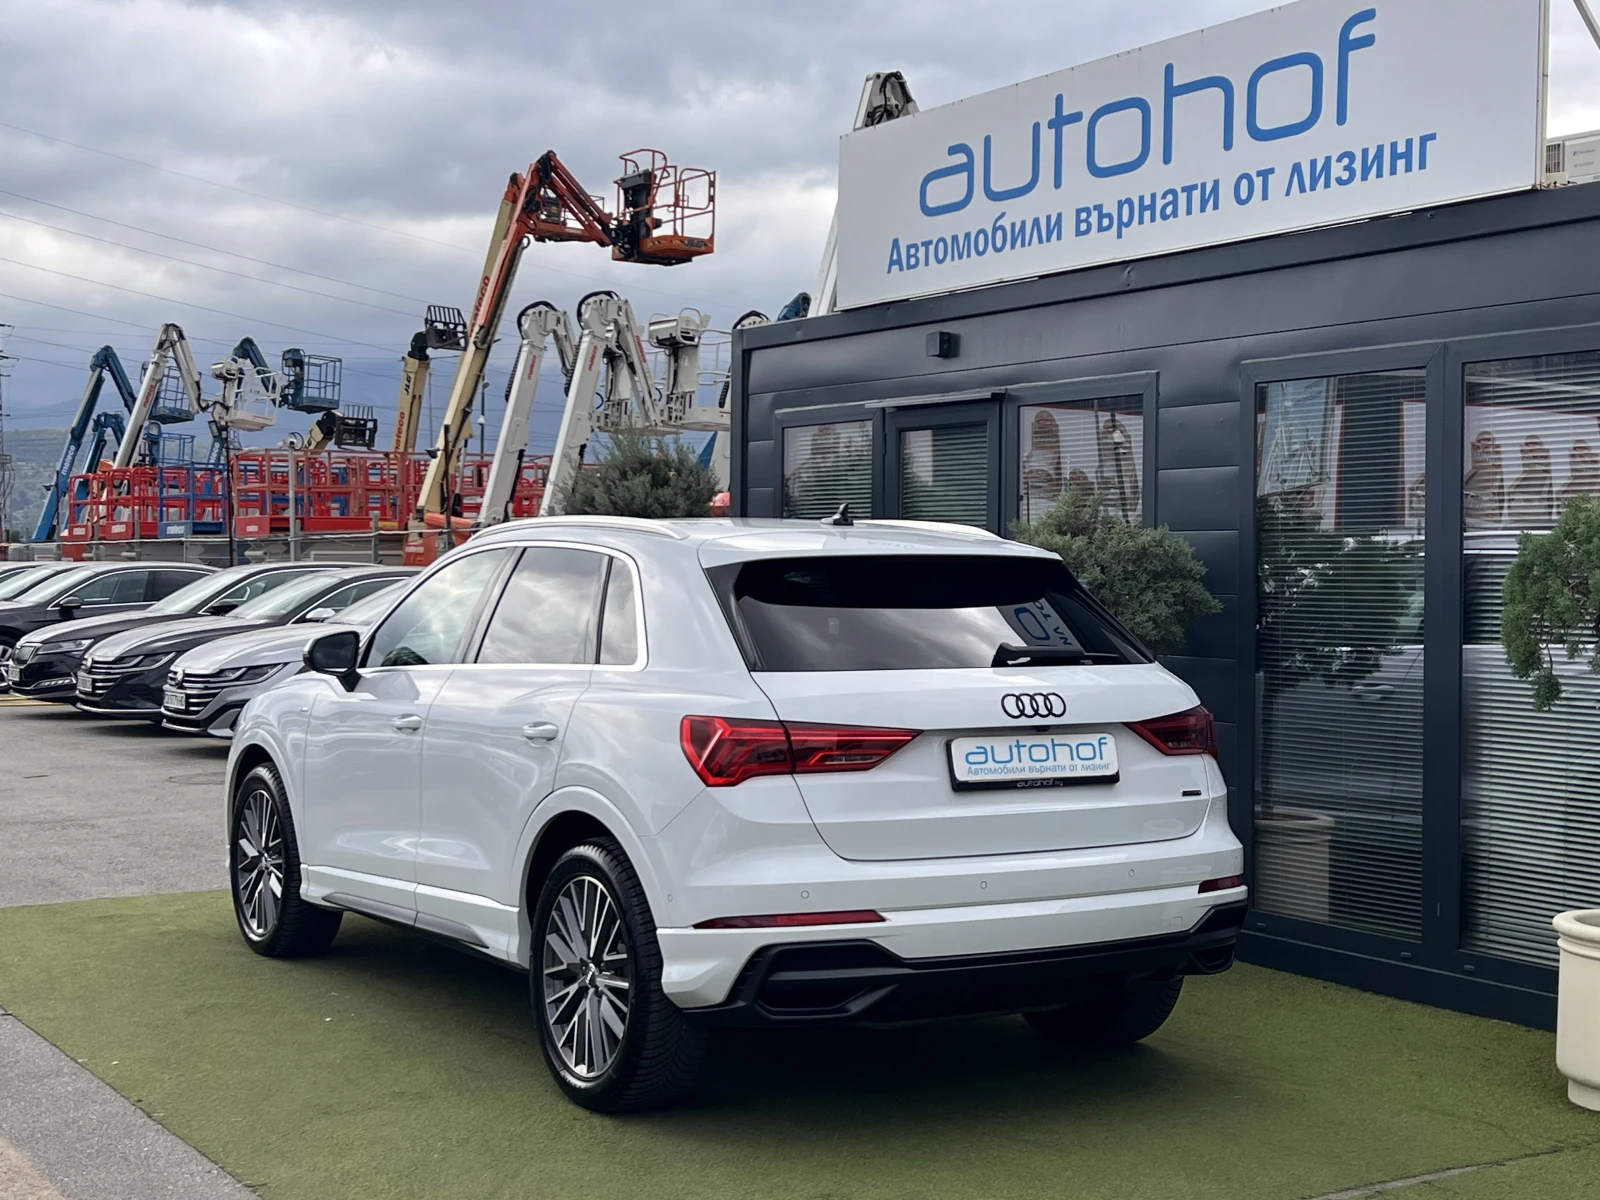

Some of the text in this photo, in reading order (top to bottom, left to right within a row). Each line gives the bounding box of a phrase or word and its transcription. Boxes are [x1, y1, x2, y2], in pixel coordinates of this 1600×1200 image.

[919, 8, 1376, 217] autohof
[887, 133, 1438, 273] Автомобили върнати от лизинг
[528, 355, 537, 380] mateco
[588, 345, 598, 371] mateco
[404, 374, 412, 396] JLG
[61, 444, 76, 476] mateco
[965, 737, 1108, 765] autohof
[967, 762, 1110, 776] Автомобили върнати от лизинг
